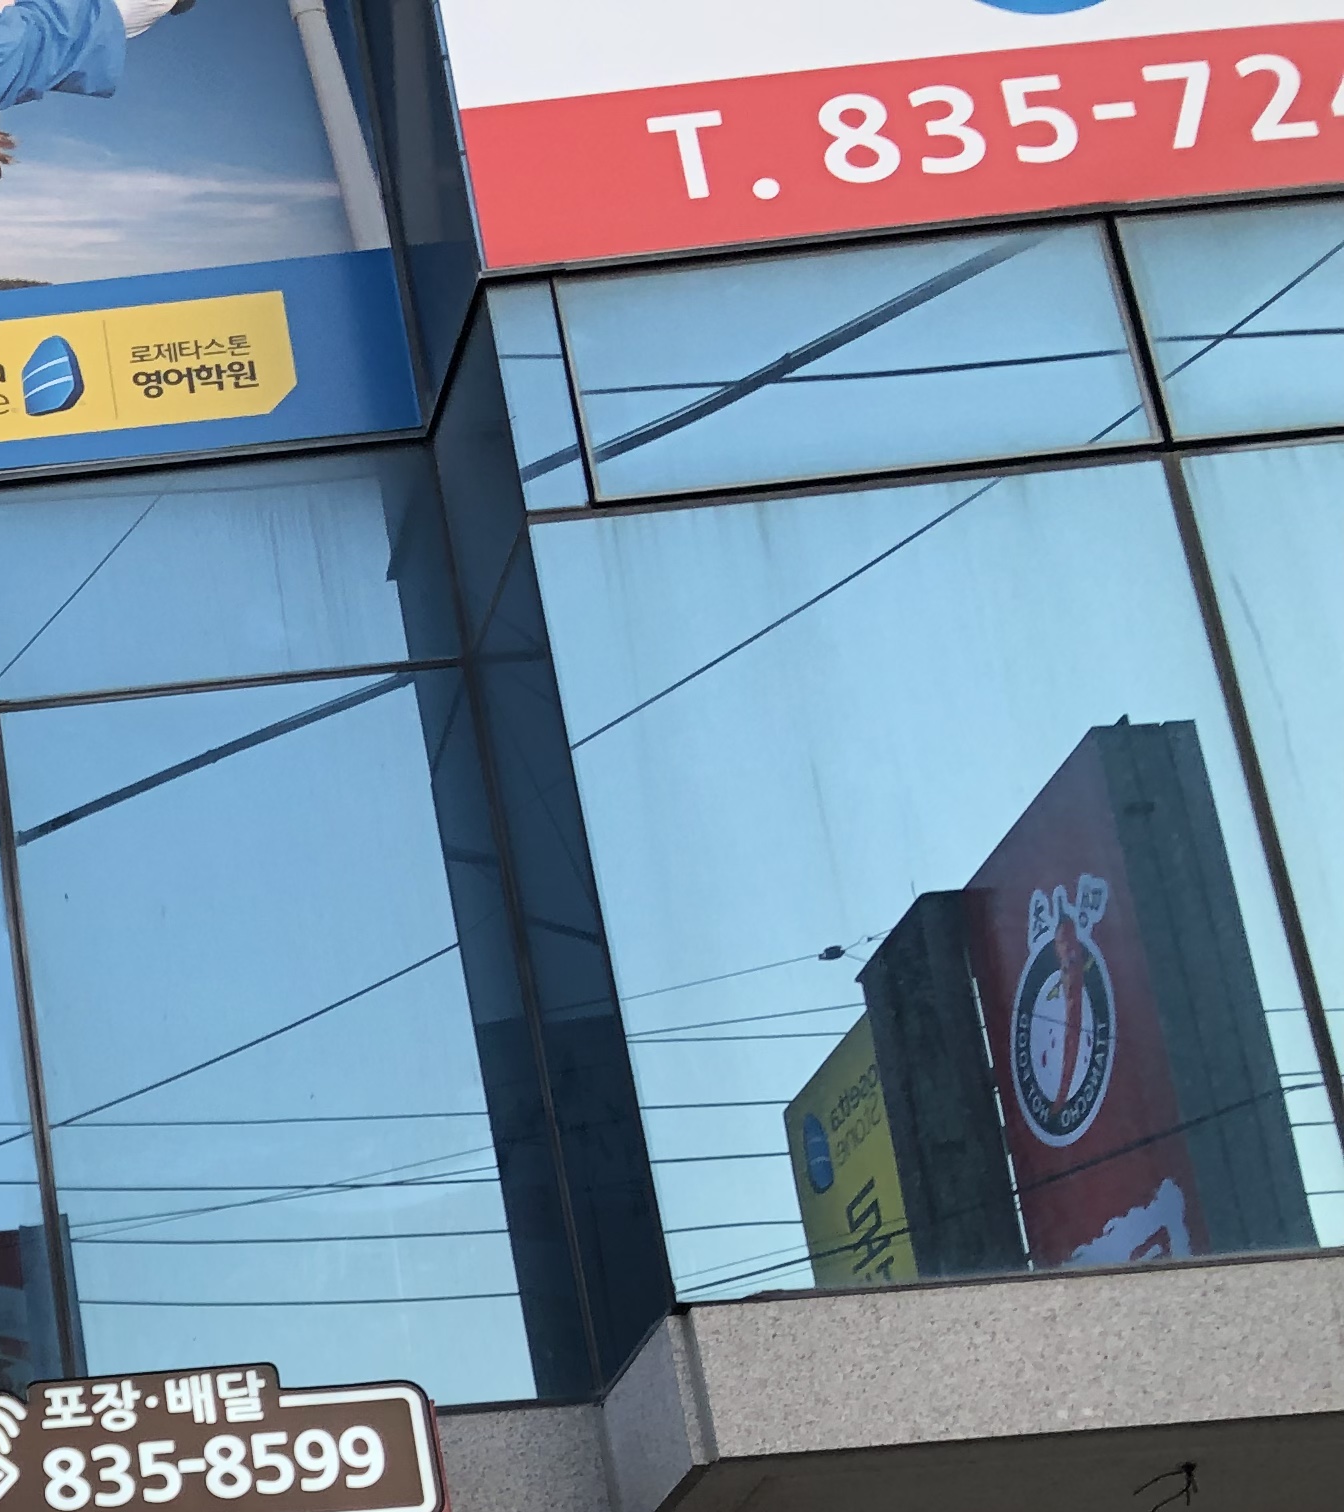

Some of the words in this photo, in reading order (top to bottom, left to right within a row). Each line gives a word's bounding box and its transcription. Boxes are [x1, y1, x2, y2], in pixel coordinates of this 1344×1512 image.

[646, 109, 781, 201] T.
[816, 53, 1344, 185] 835-72
[129, 334, 252, 364] 로제타스톤
[131, 359, 259, 399] 영어학원
[42, 1425, 386, 1512] 835-8599
